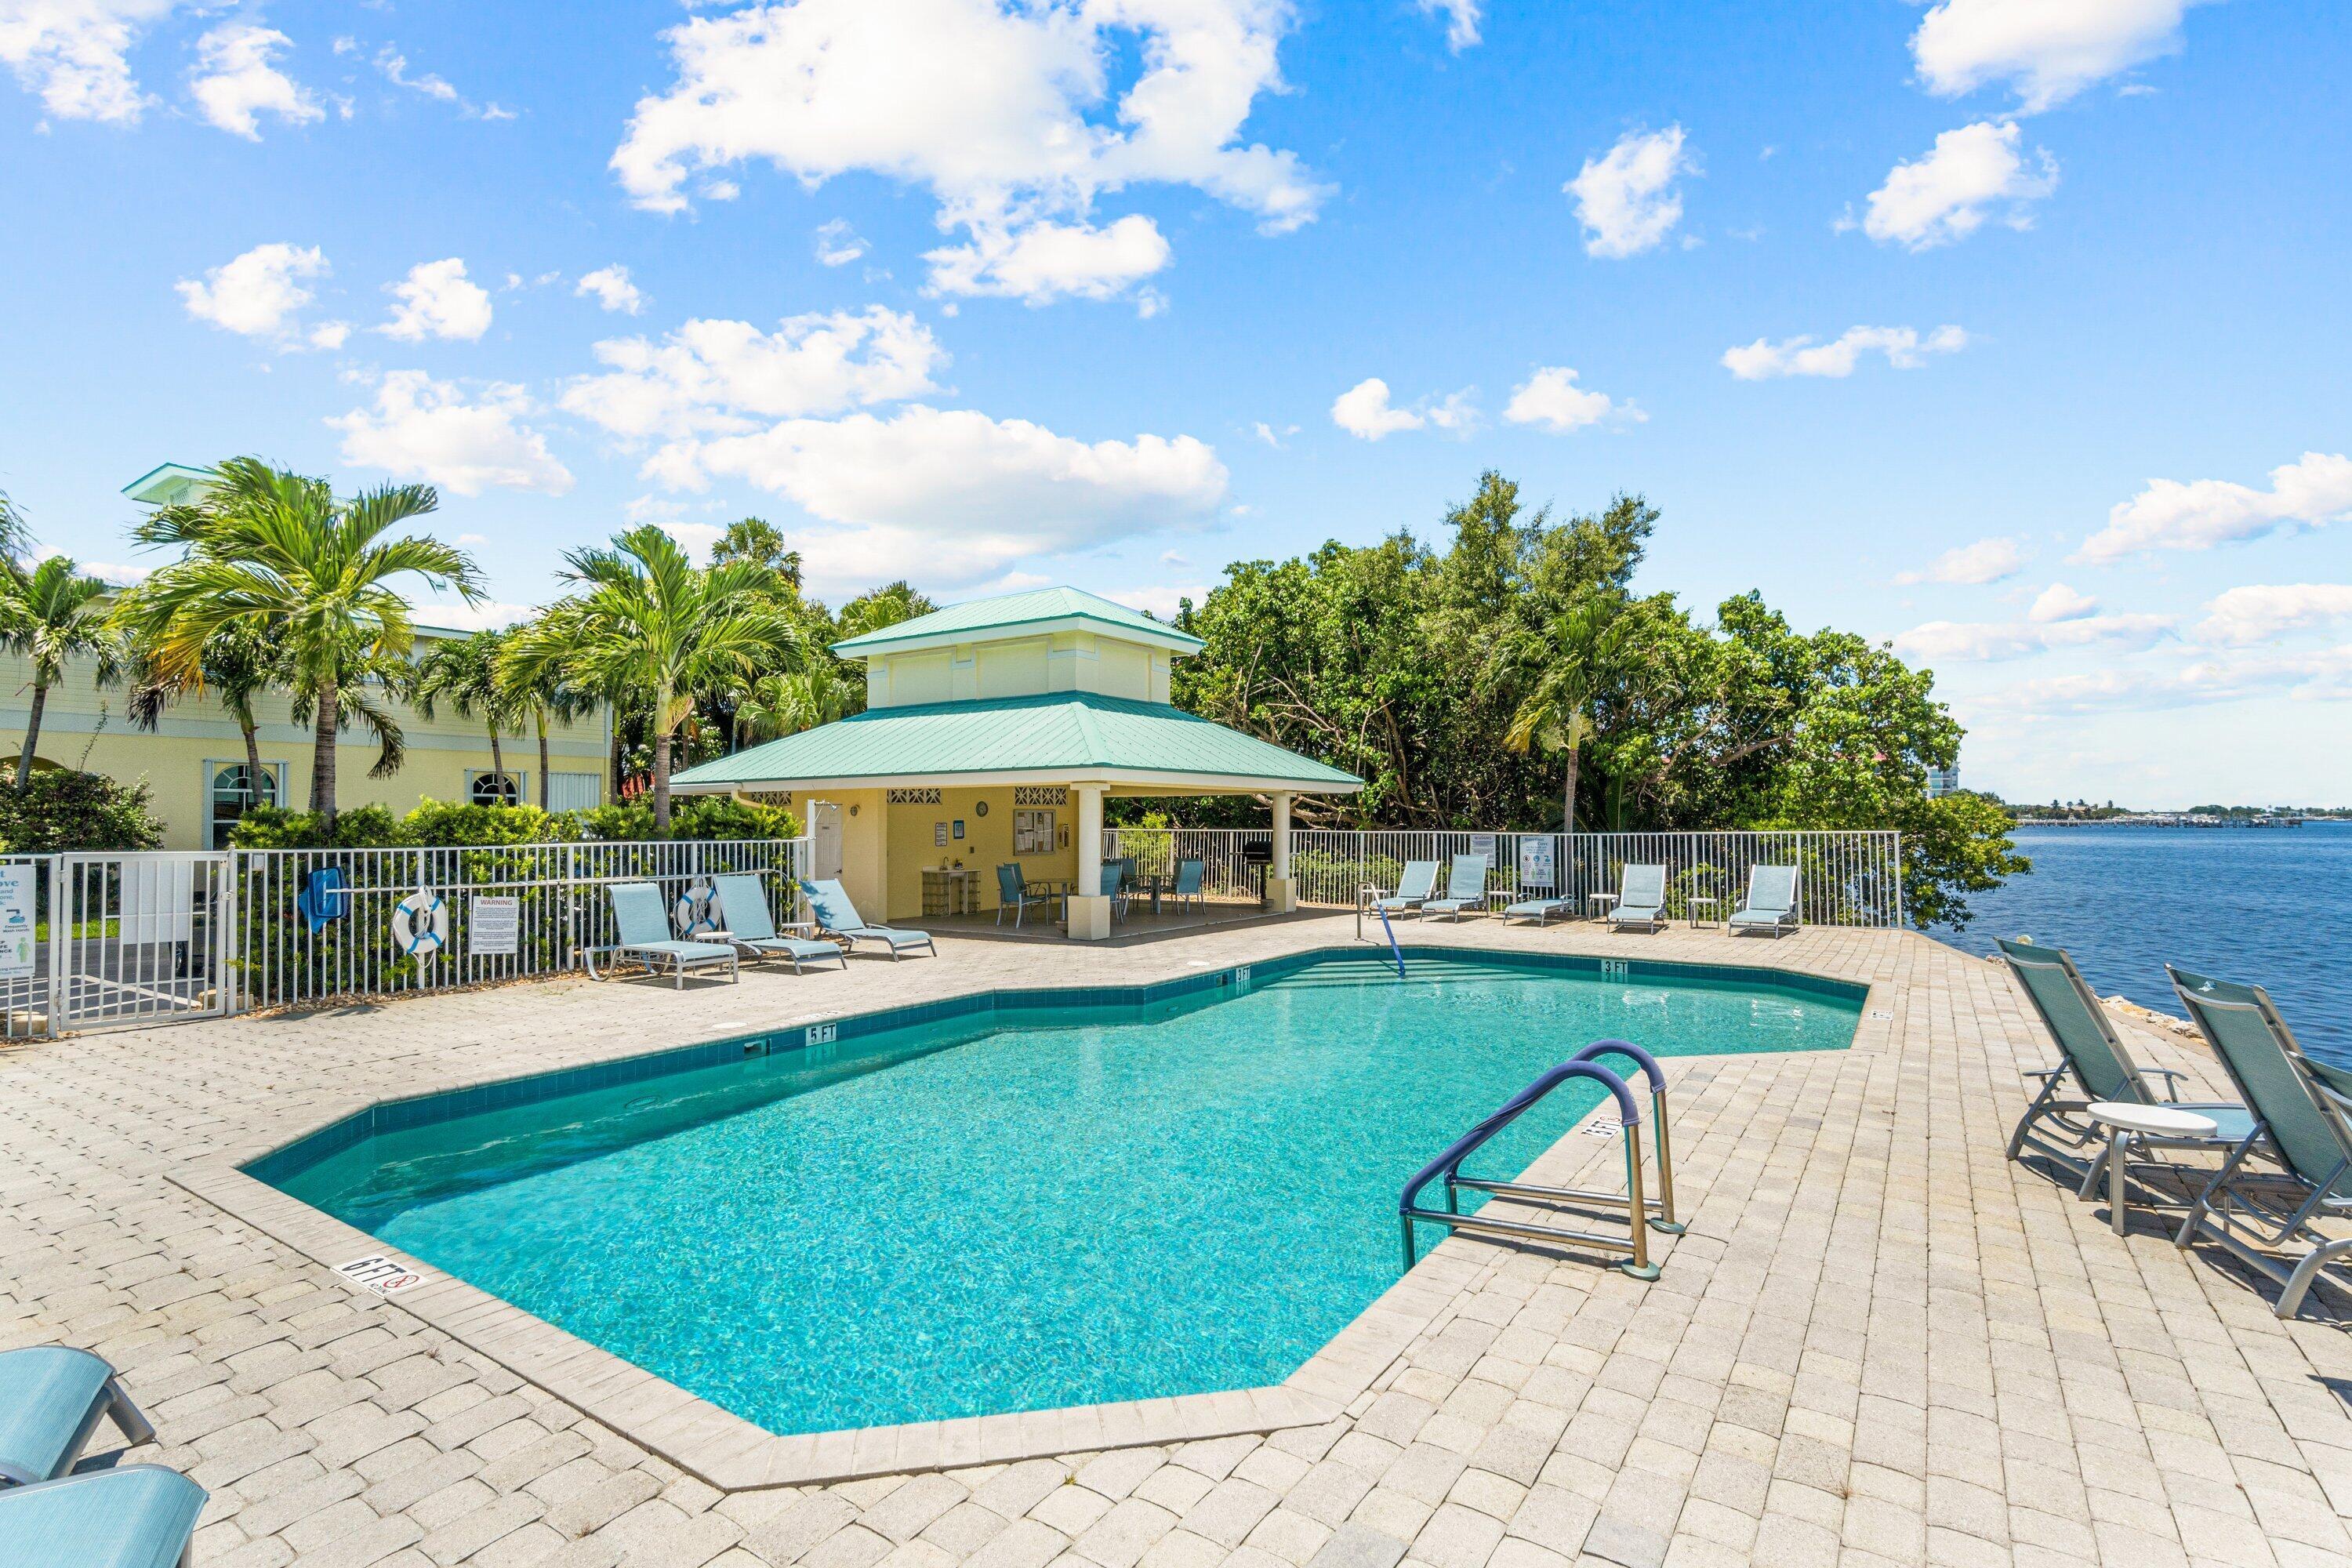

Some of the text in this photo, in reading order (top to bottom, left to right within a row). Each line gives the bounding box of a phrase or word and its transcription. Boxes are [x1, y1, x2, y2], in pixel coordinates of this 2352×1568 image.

[1238, 967, 1250, 981] 3 FT
[1605, 960, 1628, 974] 3 FT
[811, 1024, 836, 1044] 5 FT
[341, 1258, 408, 1283] 6 FT
